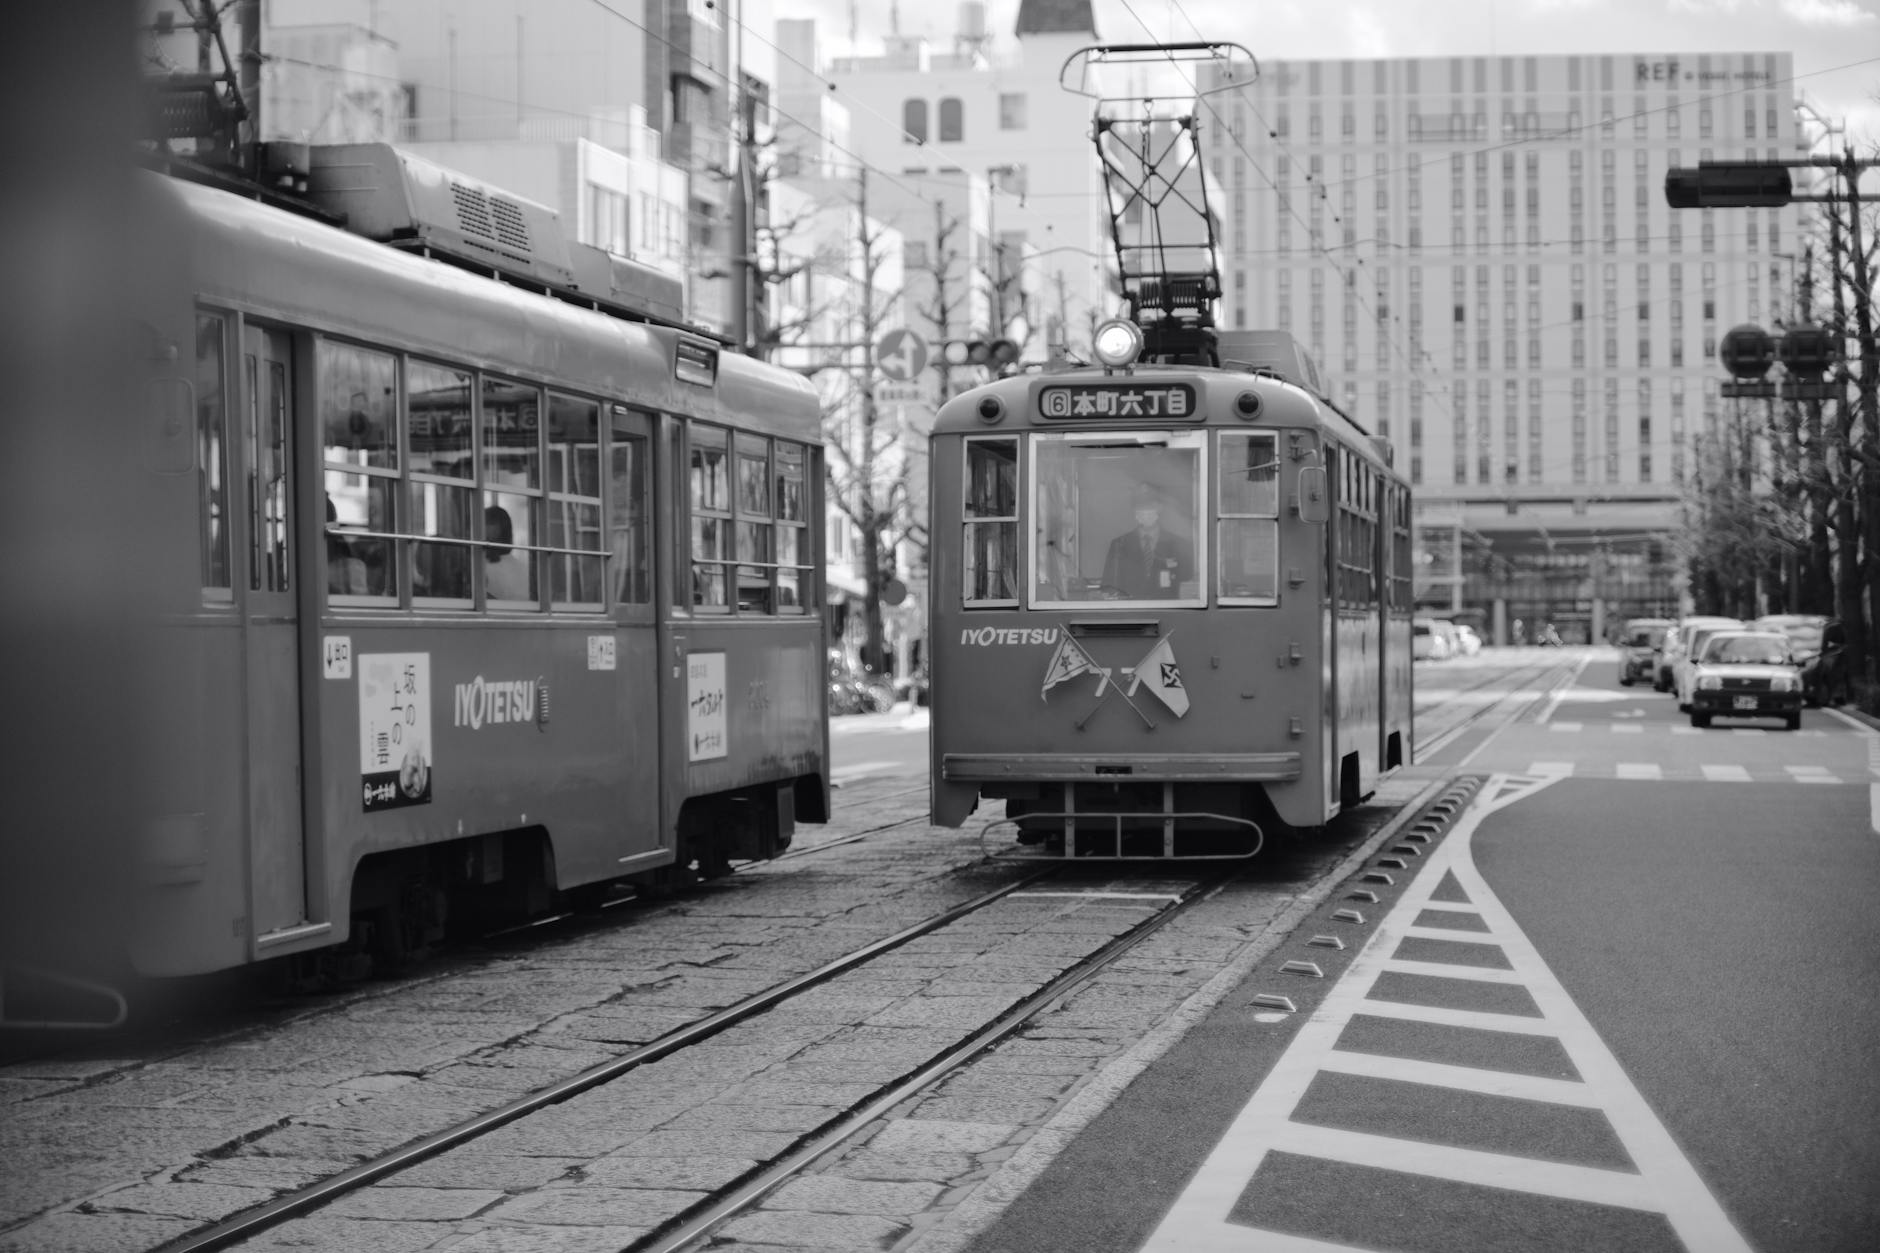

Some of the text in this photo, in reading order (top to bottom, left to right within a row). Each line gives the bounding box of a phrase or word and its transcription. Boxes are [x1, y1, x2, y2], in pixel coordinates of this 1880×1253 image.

[1636, 62, 1680, 79] REF
[1073, 390, 1186, 416] 本町六丁目
[961, 627, 1057, 646] IYOTETSU
[1089, 668, 1143, 697] 77
[455, 675, 535, 730] IYOTETSU
